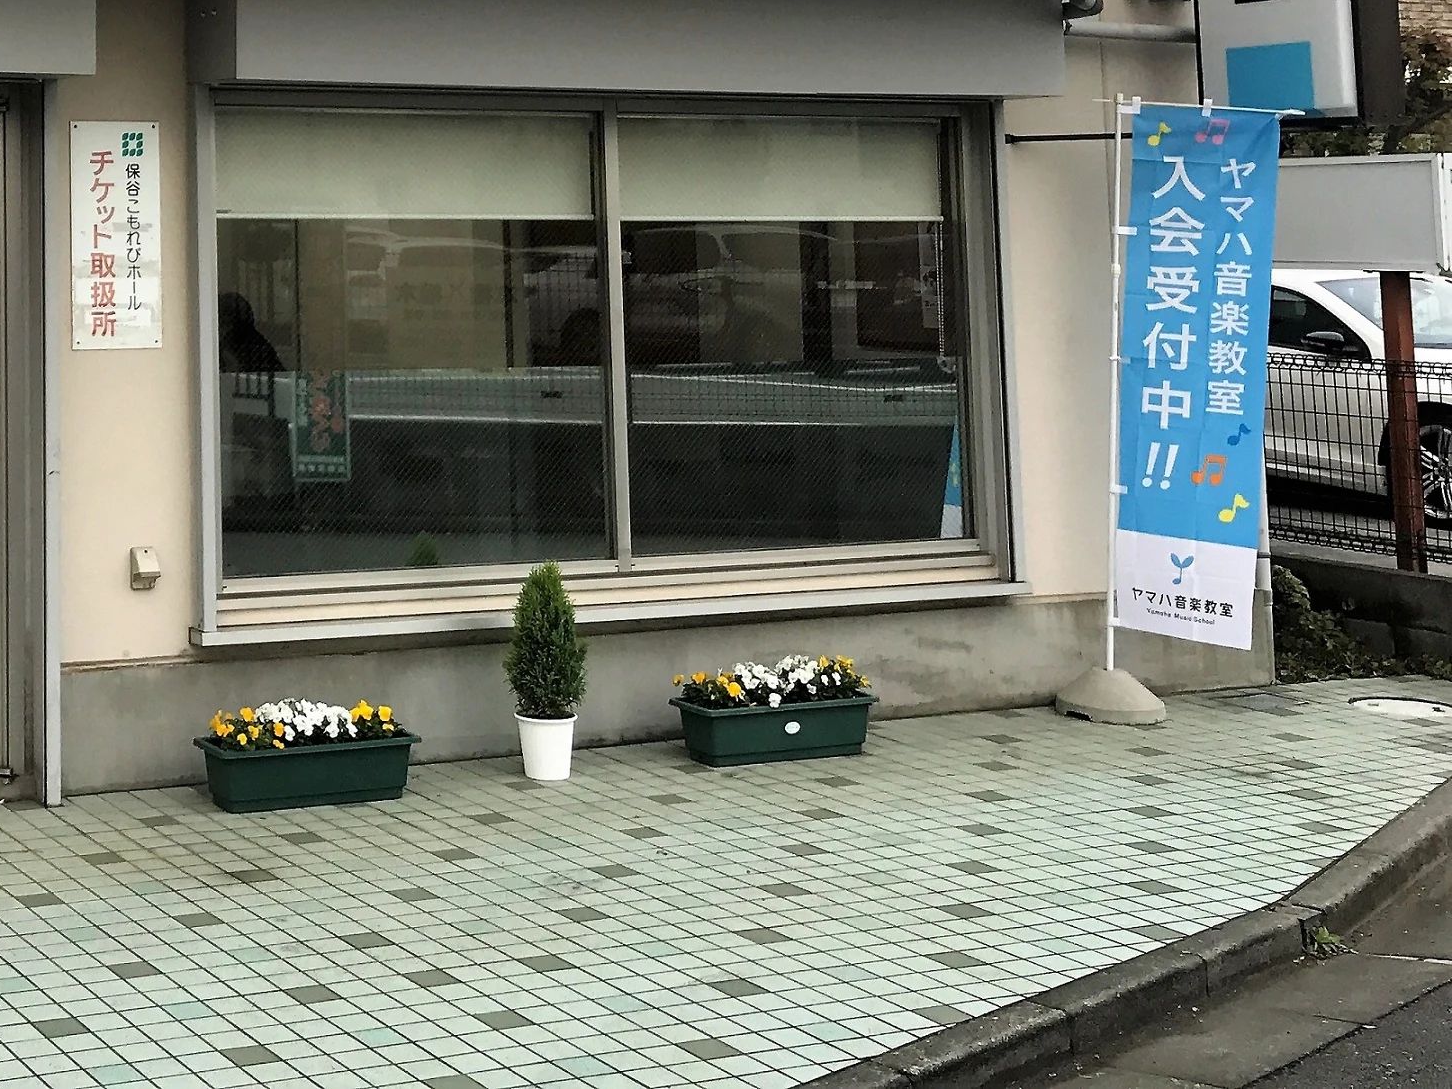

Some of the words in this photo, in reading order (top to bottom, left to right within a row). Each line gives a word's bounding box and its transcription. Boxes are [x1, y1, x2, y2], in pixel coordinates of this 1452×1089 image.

[89, 150, 117, 337] チケット取扱所
[125, 163, 142, 311] 保谷こもれびホール
[1205, 158, 1258, 417] ヤマハ音楽教室
[1132, 587, 1234, 618] ヤマハ音楽教室
